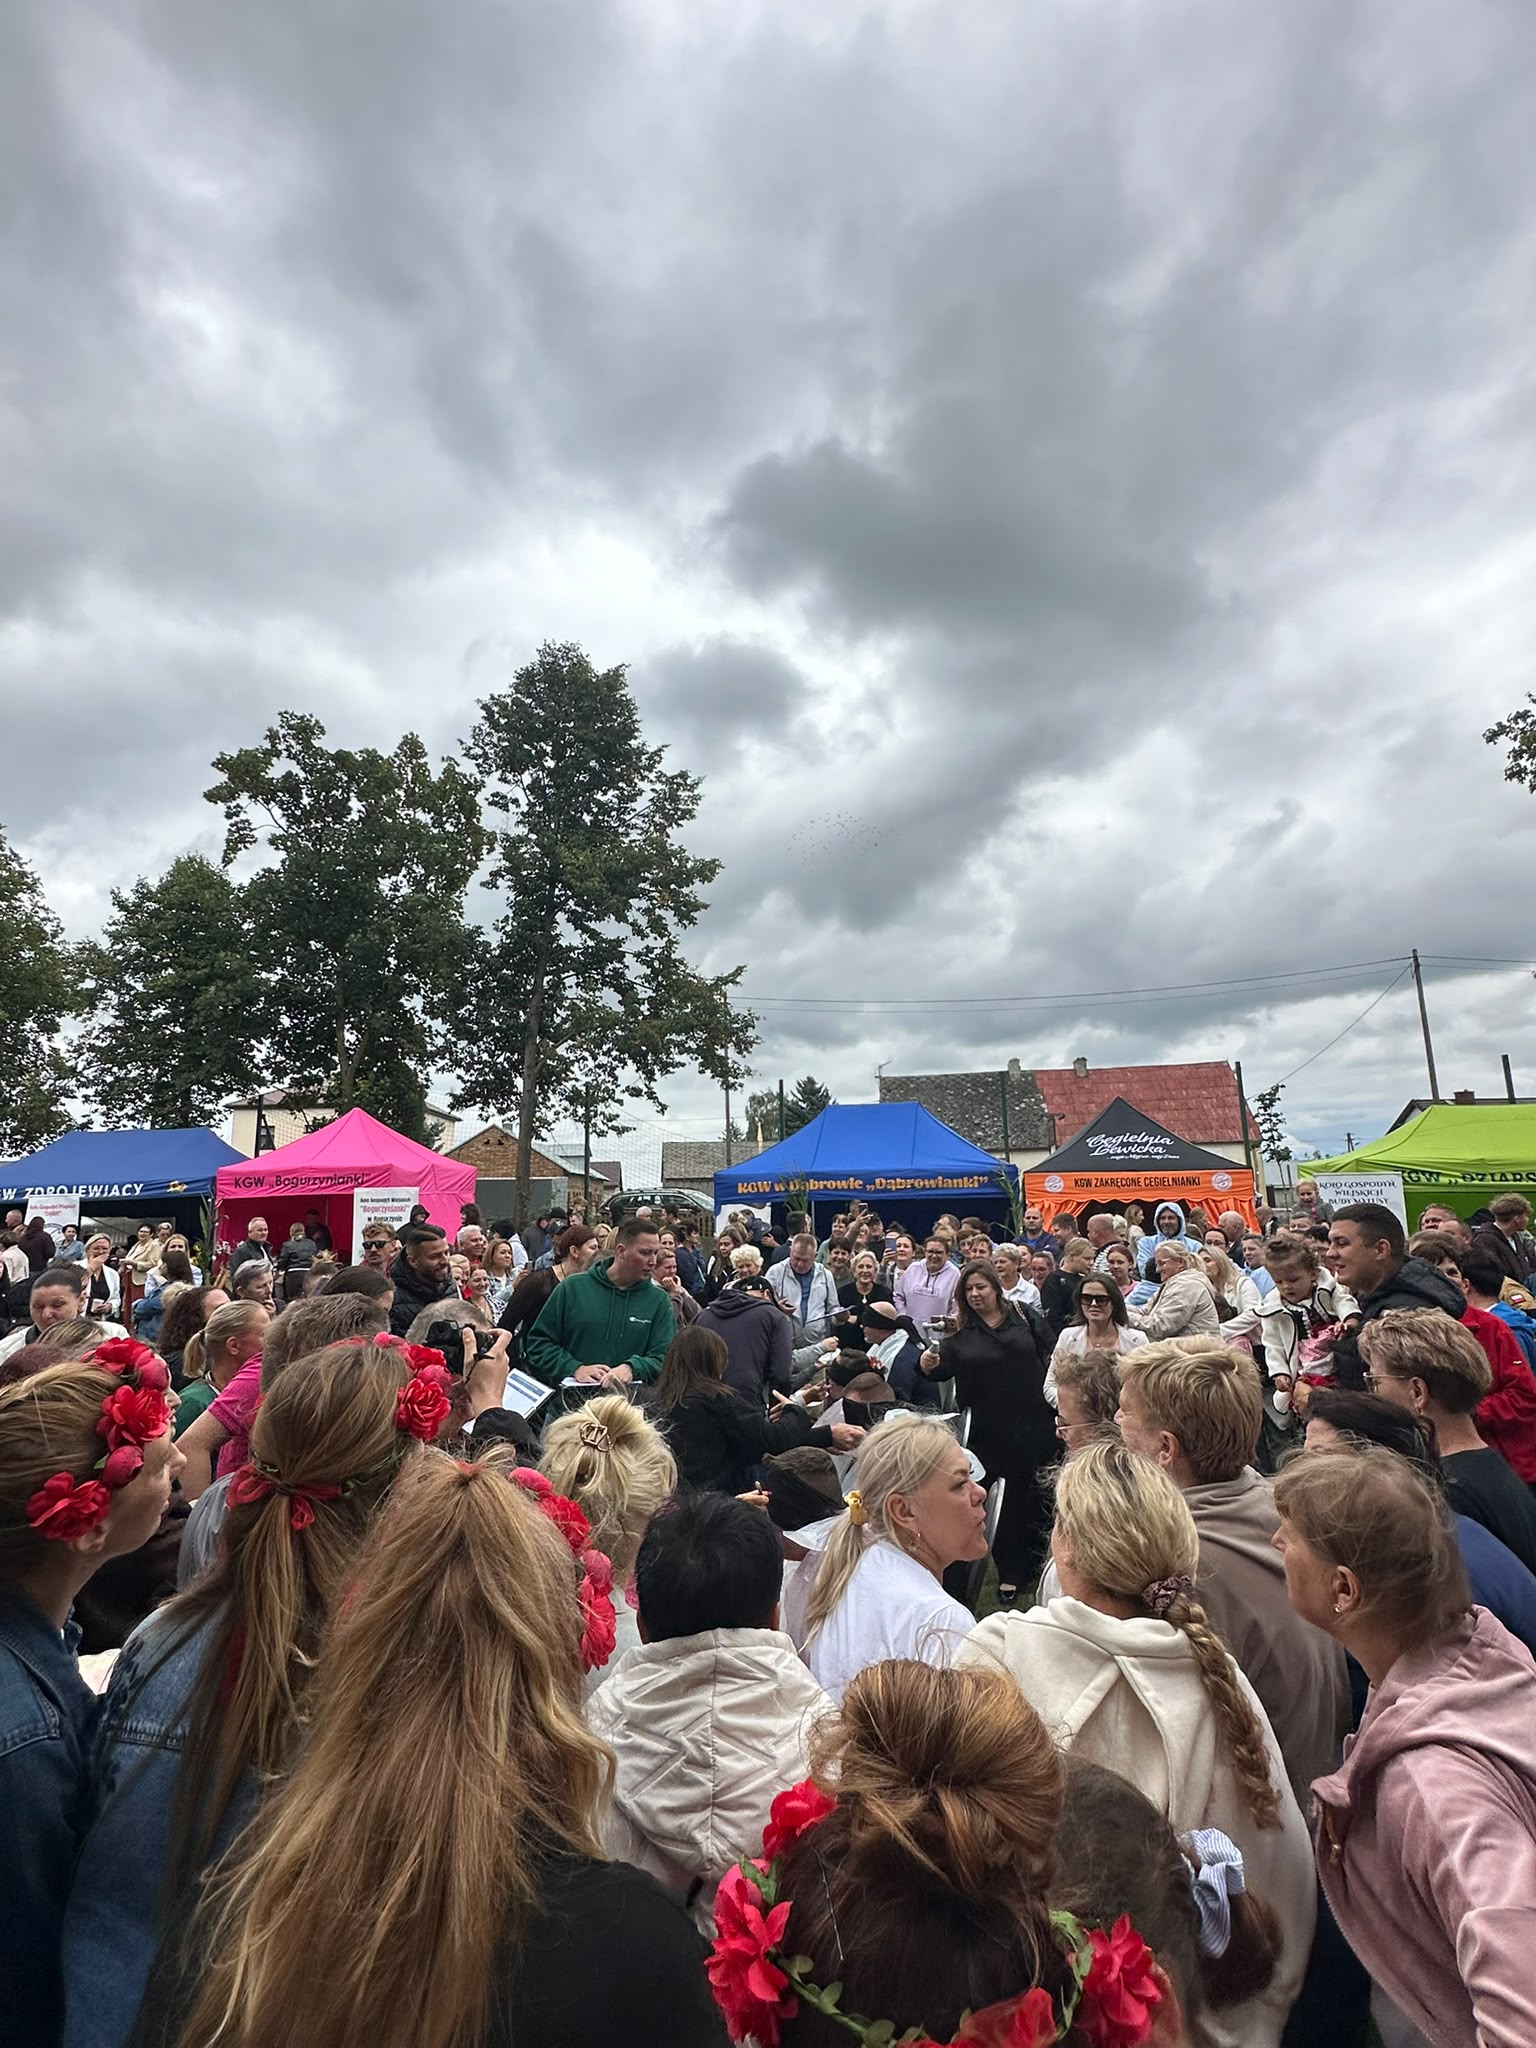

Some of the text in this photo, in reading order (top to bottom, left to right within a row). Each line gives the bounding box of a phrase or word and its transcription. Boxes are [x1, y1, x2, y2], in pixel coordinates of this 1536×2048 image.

[1086, 1131, 1174, 1148] Cegielnia
[234, 1175, 266, 1189] KGW
[737, 1180, 772, 1194] KGW
[774, 1182, 786, 1192] w
[1074, 1175, 1201, 1189] KGW ZAKRĘCONE CEGIELNIANKI
[0, 1187, 18, 1200] W
